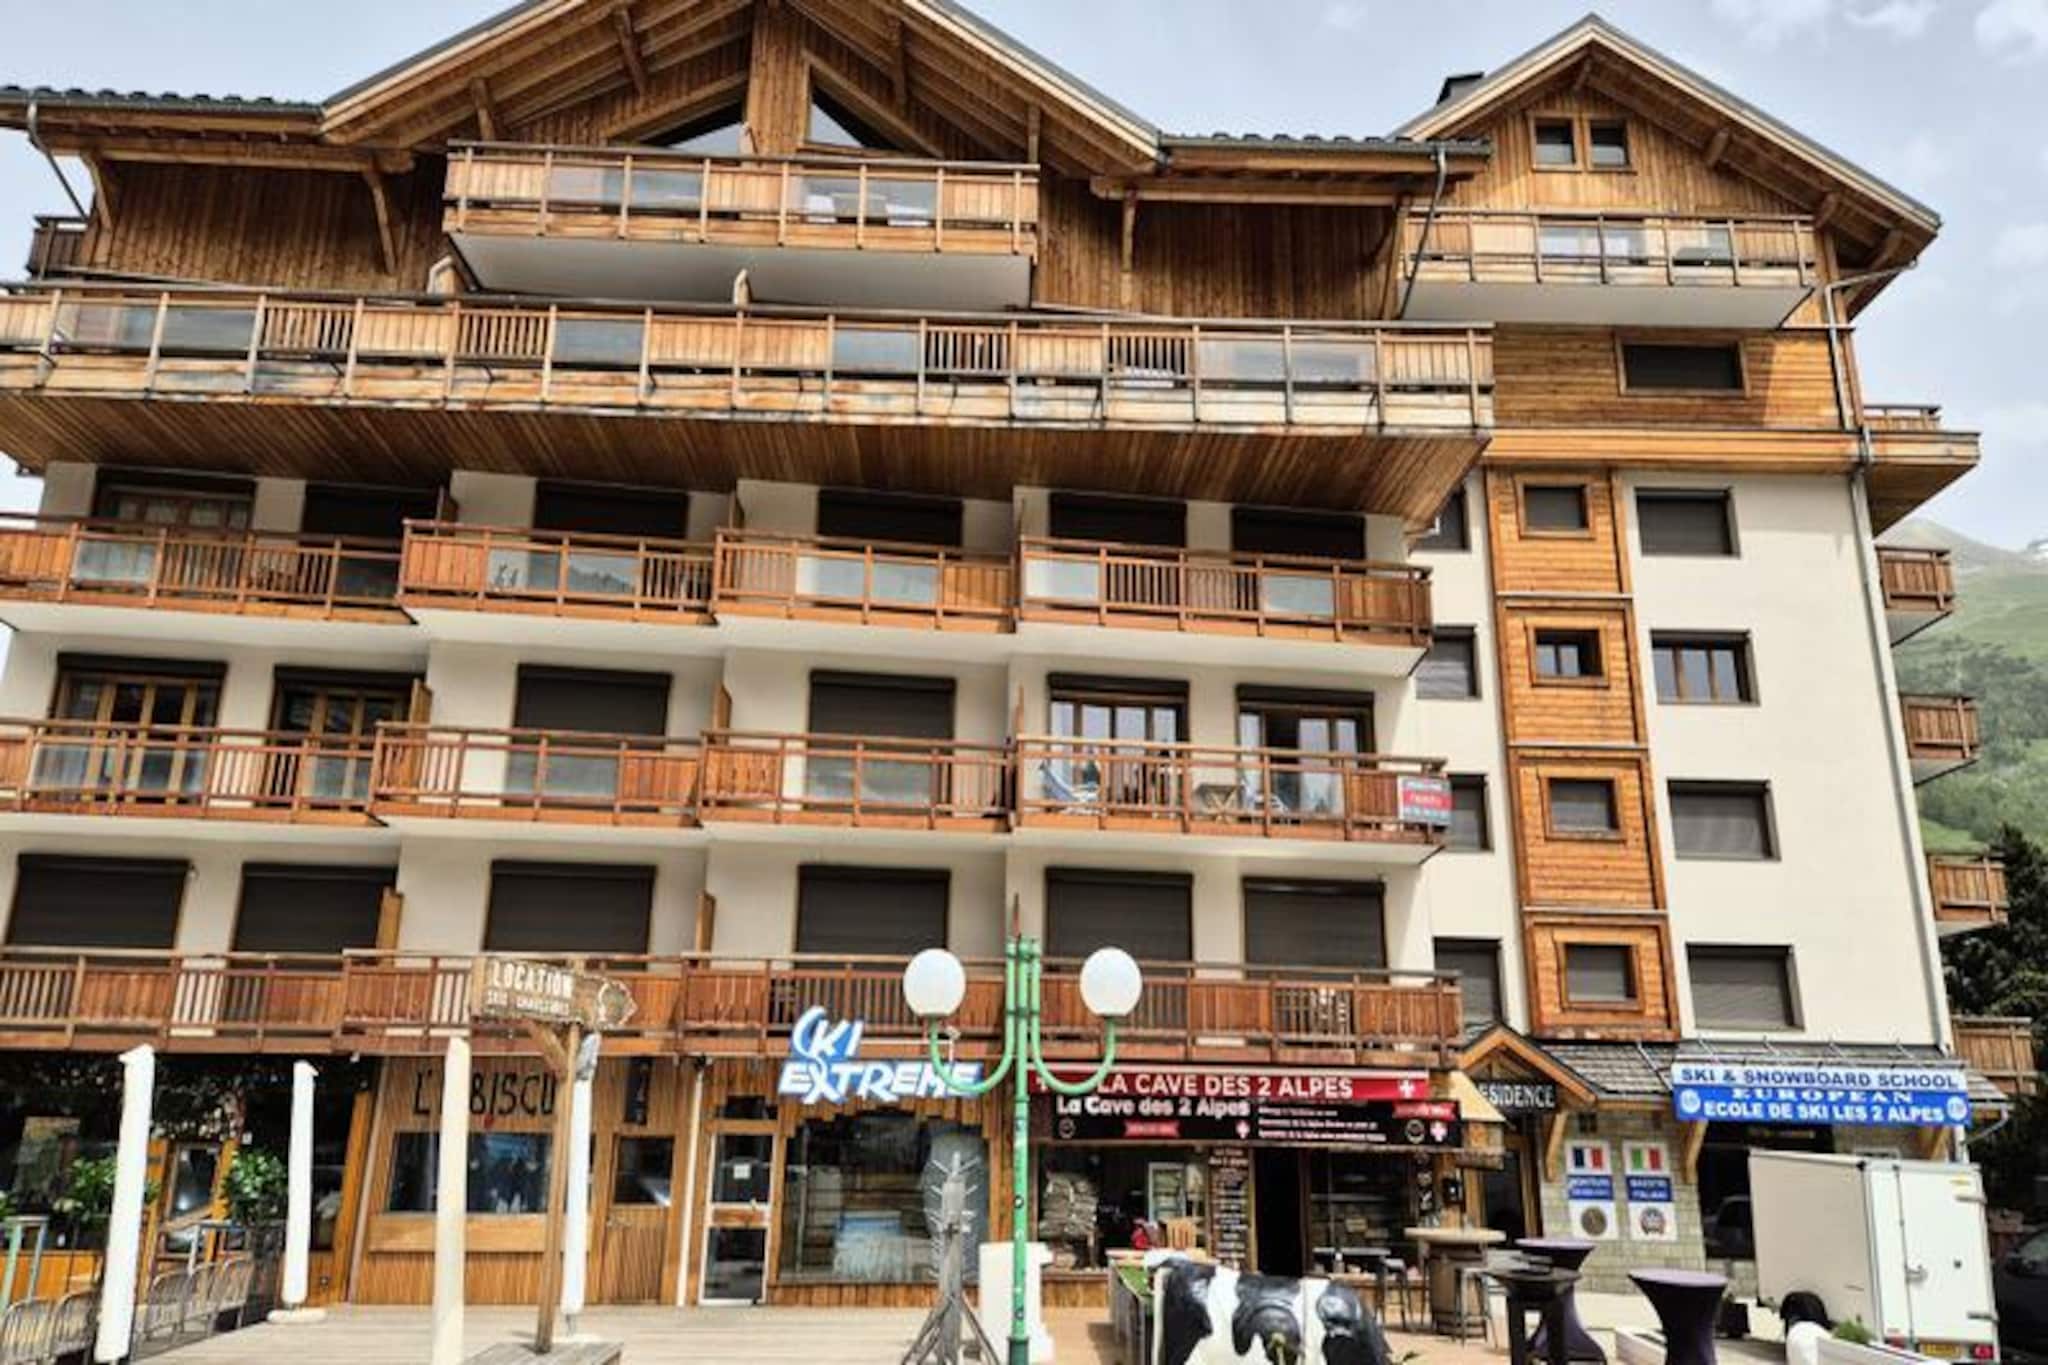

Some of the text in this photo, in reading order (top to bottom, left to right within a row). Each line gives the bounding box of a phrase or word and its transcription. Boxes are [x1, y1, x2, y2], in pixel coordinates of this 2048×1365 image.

[491, 960, 574, 998] LOCATION
[792, 1006, 864, 1058] SKI
[778, 1060, 983, 1104] EXTREME
[1097, 1074, 1353, 1098] LA CAVE DES 2 ALPES
[1681, 1068, 1959, 1088] SKI & SNOWBOARD SCHOOL
[1056, 1095, 1082, 1114] La
[1084, 1095, 1135, 1115] Cave
[1138, 1097, 1174, 1116] des
[1178, 1098, 1192, 1116] 2
[1196, 1098, 1250, 1119] Alpes
[1478, 1082, 1556, 1108] ESIDENCE
[1732, 1087, 1913, 1104] EUROPEAN
[1703, 1101, 1764, 1118] ECOLE
[1768, 1102, 1793, 1119] DE
[1797, 1103, 1829, 1120] SKI
[1832, 1104, 1868, 1121] LES
[1872, 1105, 1885, 1122] 2
[1888, 1106, 1945, 1122] ALPES
